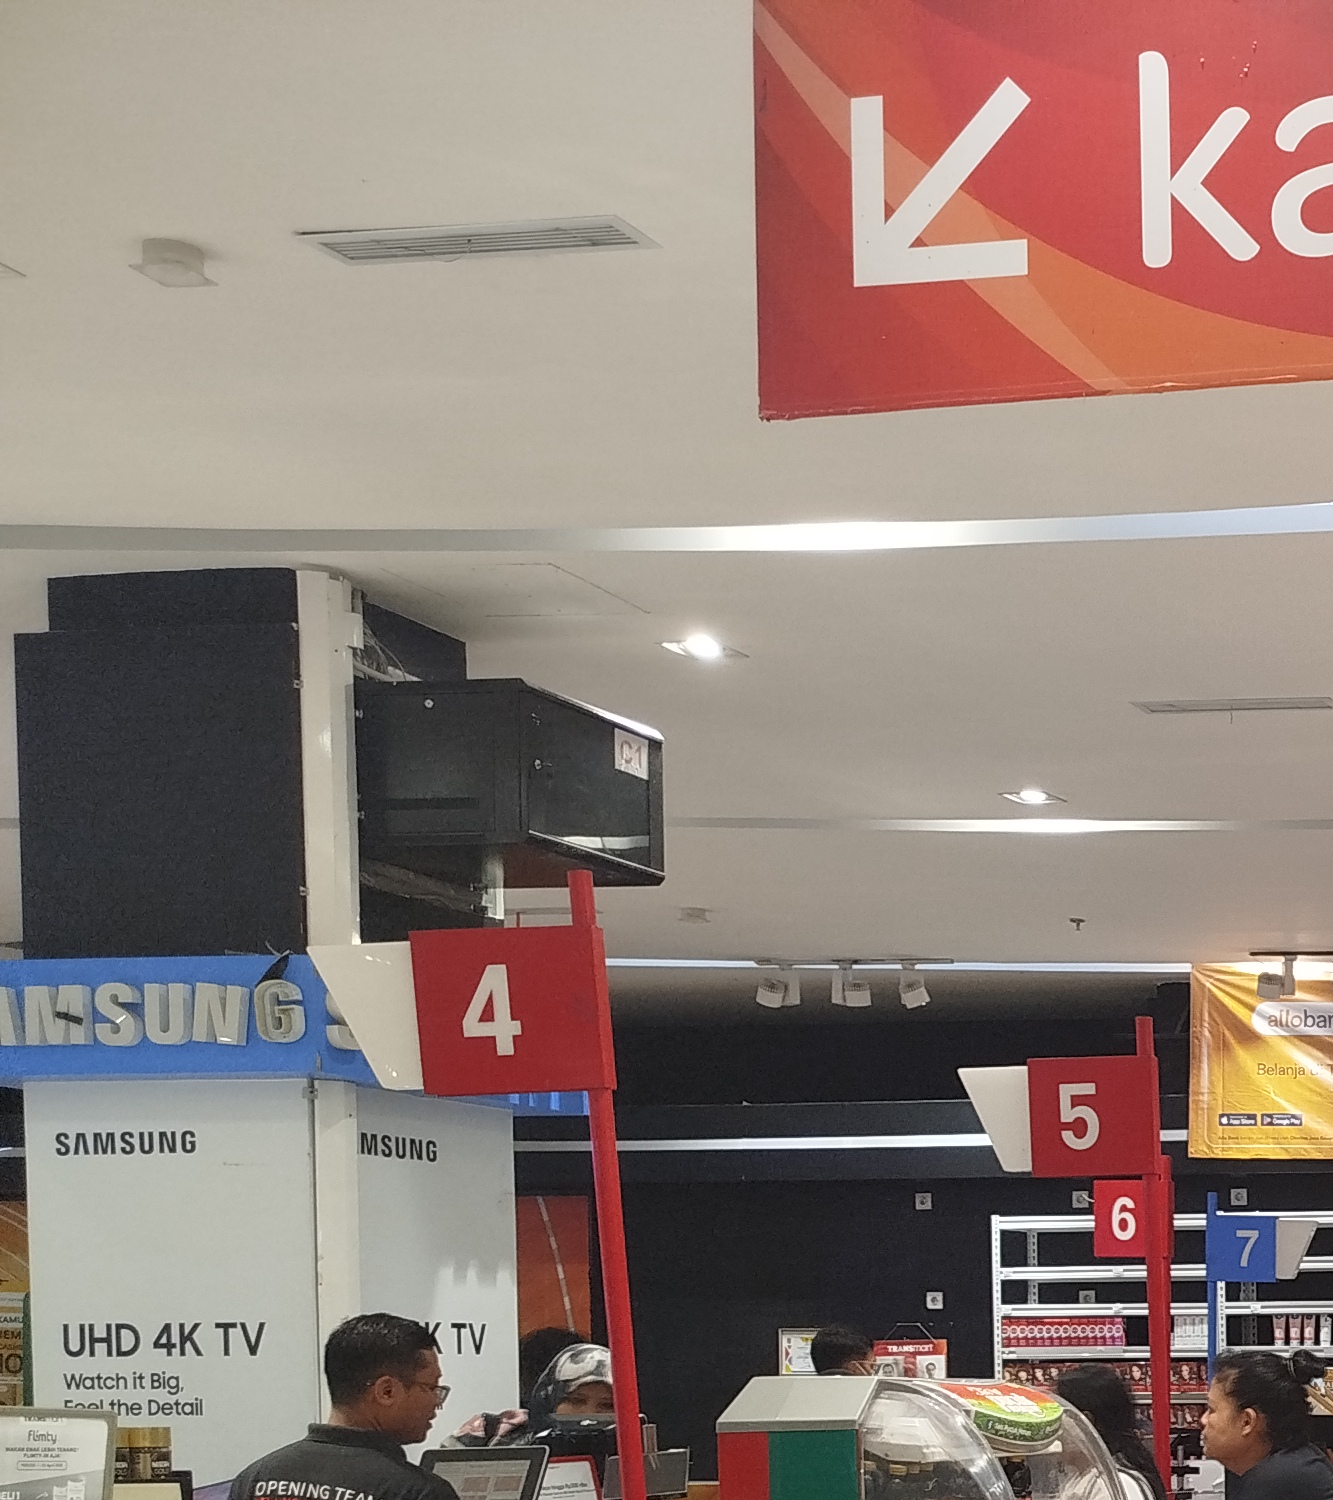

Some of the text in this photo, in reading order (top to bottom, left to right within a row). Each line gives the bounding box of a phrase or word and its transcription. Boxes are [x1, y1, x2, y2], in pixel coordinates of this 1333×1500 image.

[0, 980, 305, 1046] MSUNG
[462, 964, 521, 1056] 4
[1257, 1063, 1306, 1079] Belanja
[1310, 1063, 1322, 1076] di
[1059, 1082, 1099, 1150] 5
[55, 1130, 197, 1157] SAMSUNG
[357, 1132, 438, 1162] MSUNG
[1111, 1196, 1136, 1240] 6
[1235, 1229, 1260, 1267] 7
[63, 1322, 266, 1357] UHD 4K TV
[425, 1322, 487, 1354] K TV
[64, 1371, 185, 1395] Watch it Big,
[109, 1399, 142, 1416] the
[148, 1399, 203, 1416] Detail
[255, 1481, 331, 1499] OPENING
